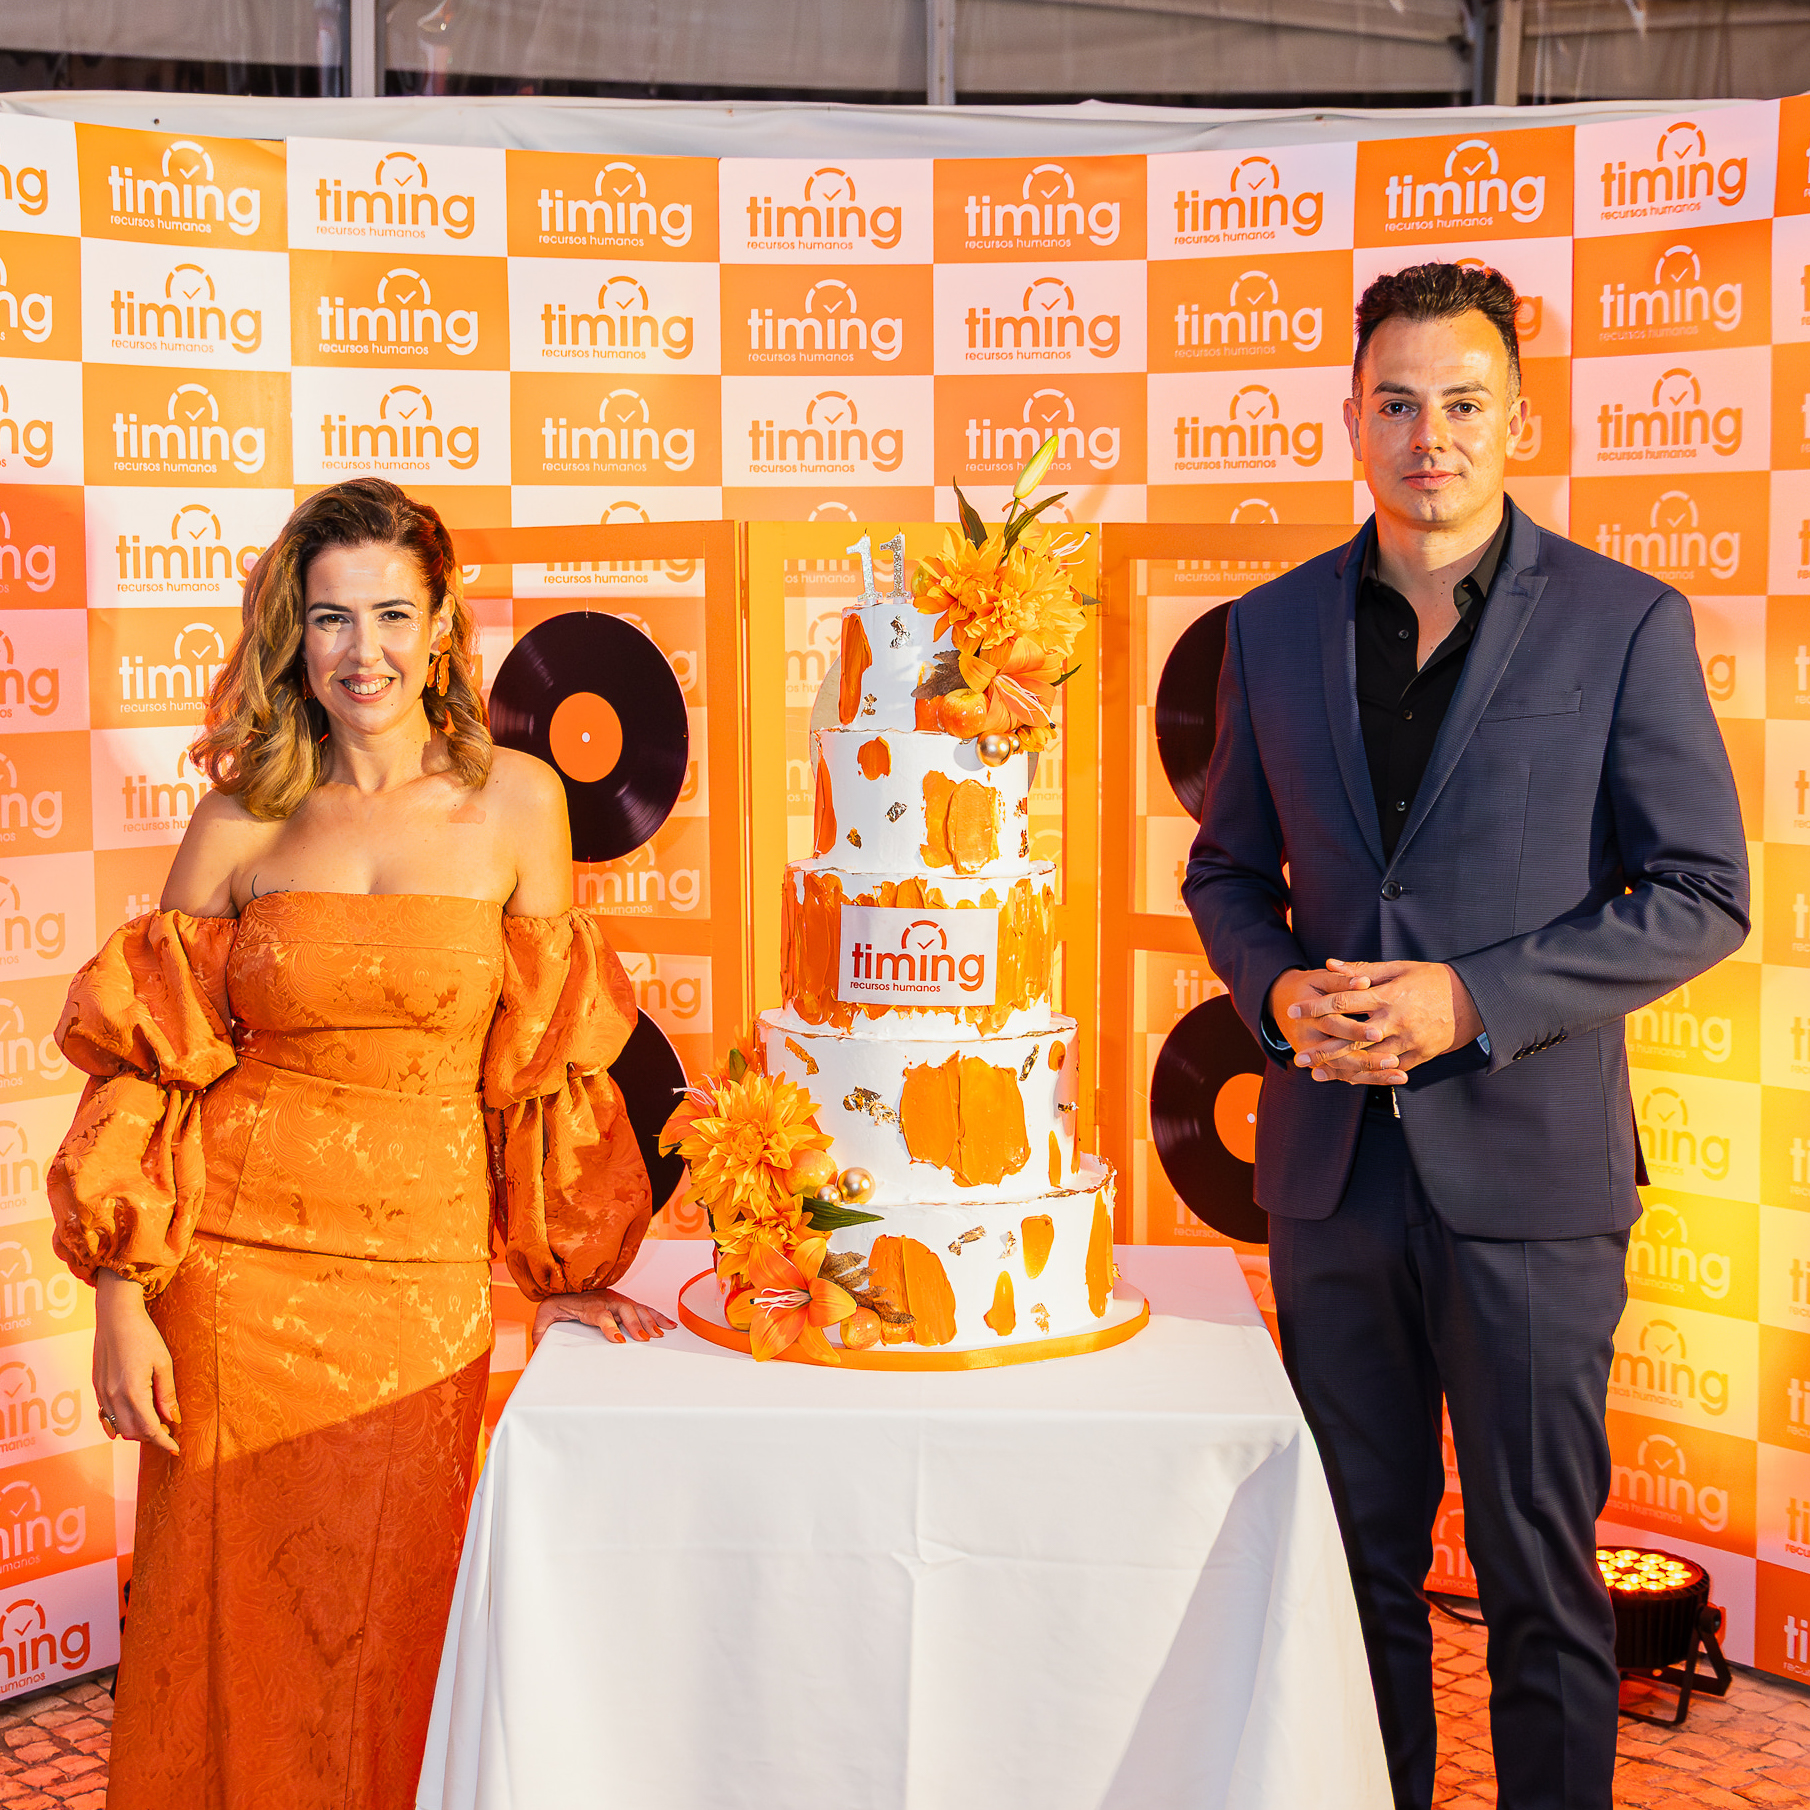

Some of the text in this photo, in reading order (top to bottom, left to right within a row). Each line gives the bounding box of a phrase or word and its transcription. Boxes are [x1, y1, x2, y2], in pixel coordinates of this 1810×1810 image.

[1600, 157, 1747, 207] timing
[108, 165, 261, 236] timing
[315, 177, 475, 240] timing
[1385, 175, 1545, 223] timing
[537, 189, 693, 248] timing
[1174, 190, 1323, 236] timing
[1601, 201, 1701, 220] recursos humanos
[110, 214, 211, 233] recursos humanos
[747, 196, 901, 249] timing
[965, 196, 1120, 246] timing
[1385, 217, 1493, 231] recursos humanos
[316, 225, 426, 239] recursos humanos
[538, 235, 644, 247] recursos humanos
[1174, 230, 1275, 245] recursos humanos
[747, 239, 853, 250] recursos humanos
[965, 238, 1071, 249] recursos humanos
[1600, 283, 1742, 331] timing
[111, 289, 262, 354] timing
[317, 295, 478, 355] timing
[1174, 304, 1322, 352] timing
[541, 304, 694, 360] timing
[748, 308, 903, 361] timing
[965, 308, 1120, 358] timing
[1600, 326, 1698, 341] recursos humanos
[111, 339, 214, 354] recursos humanos
[318, 342, 429, 356] recursos humanos
[542, 348, 646, 360] recursos humanos
[965, 349, 1071, 360] recursos humanos
[1174, 345, 1275, 358] recursos humanos
[748, 351, 854, 362] recursos humanos
[1598, 404, 1742, 456] timing
[112, 412, 265, 474] timing
[321, 414, 479, 470] timing
[542, 418, 695, 472] timing
[749, 420, 903, 472] timing
[1174, 416, 1323, 466] timing
[1598, 448, 1697, 461] recursos humanos
[113, 461, 217, 474] recursos humanos
[321, 459, 430, 470] recursos humanos
[543, 461, 647, 472] recursos humanos
[749, 462, 855, 473] recursos humanos
[966, 463, 1013, 471] recursos
[1174, 458, 1276, 471] recursos humanos
[117, 581, 219, 593] recursos humanos
[544, 573, 648, 584] recursos humanos
[801, 573, 856, 583] humanos
[1175, 573, 1220, 582] recursos
[119, 656, 227, 699] timi
[120, 702, 166, 712] recursos
[123, 822, 169, 832] recursos
[578, 868, 700, 912] ming
[600, 904, 653, 914] humanos
[852, 943, 985, 992] timing
[850, 981, 941, 992] recursos humanos
[1613, 1351, 1728, 1416] ming
[1611, 1464, 1728, 1532] ming
[1, 1671, 45, 1694] umanos
